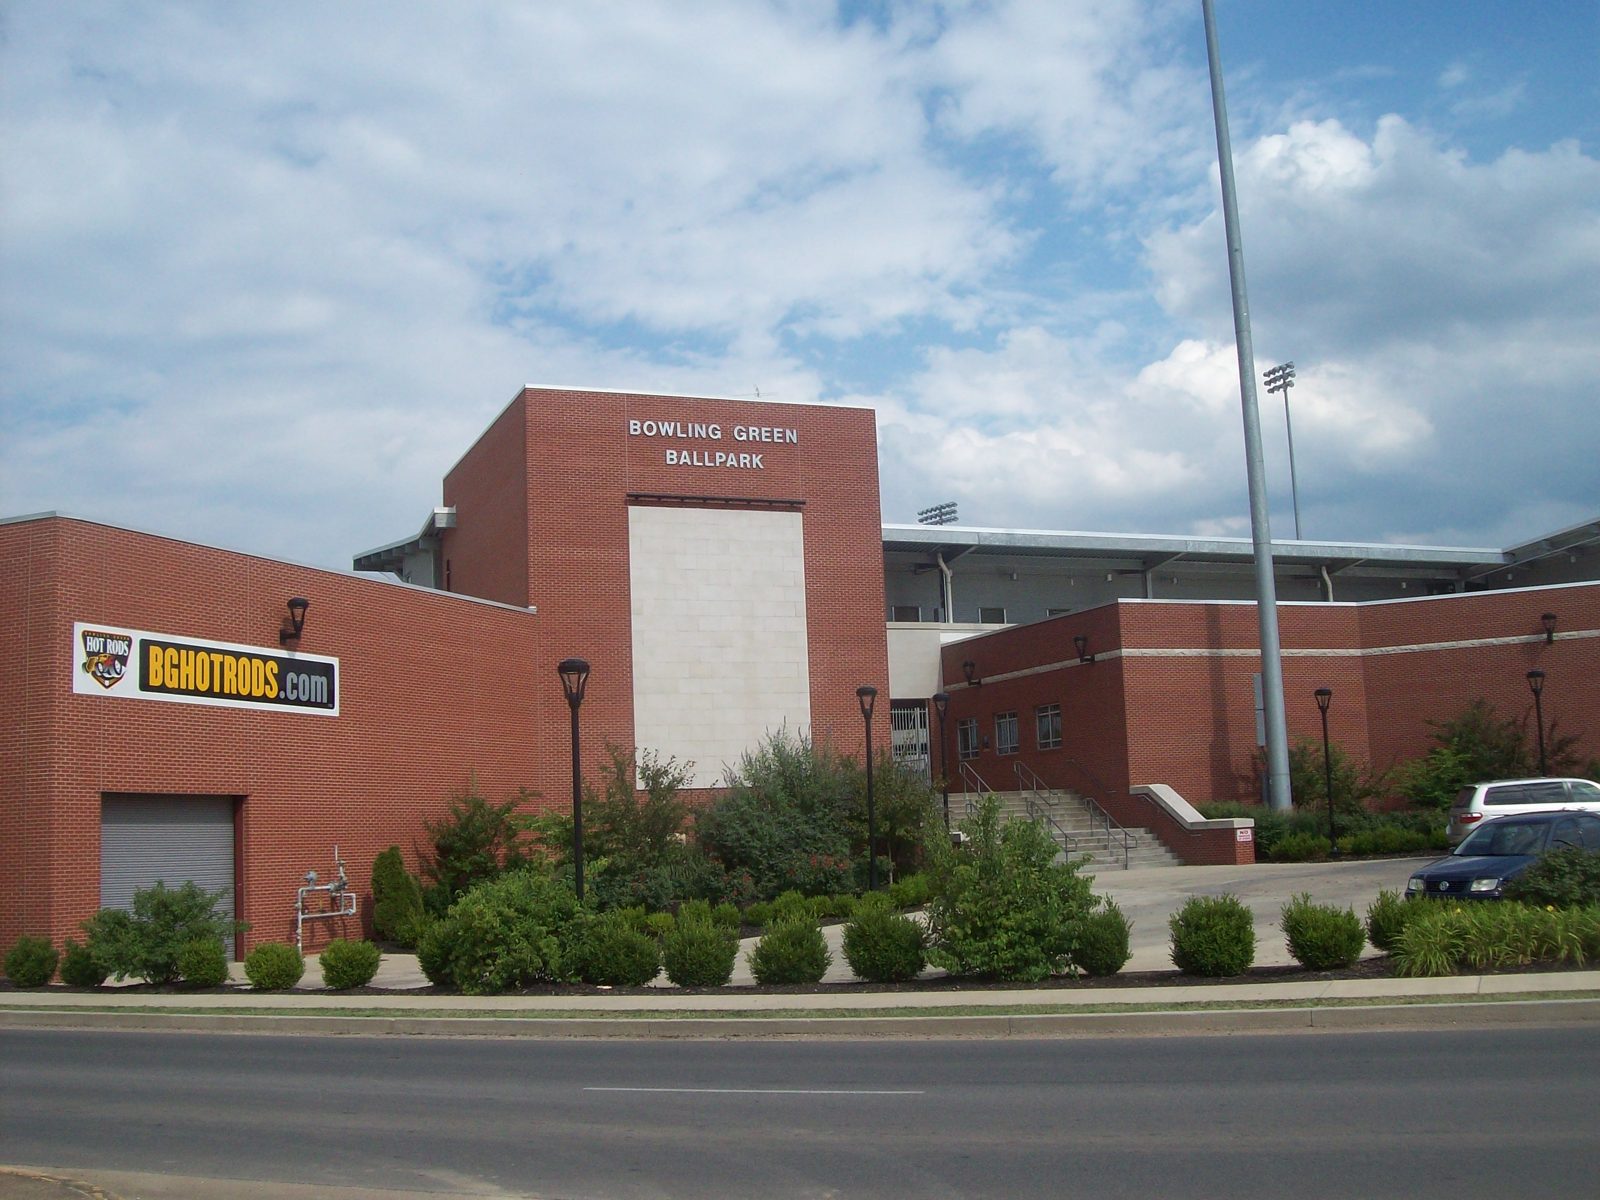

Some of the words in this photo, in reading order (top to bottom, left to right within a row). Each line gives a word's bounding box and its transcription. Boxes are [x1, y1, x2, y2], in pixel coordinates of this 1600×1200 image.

[629, 420, 722, 439] BOWLING
[733, 426, 798, 444] GREEN
[666, 450, 764, 469] BALLPARK
[86, 636, 105, 652] HOT
[107, 639, 129, 656] RODS
[149, 645, 327, 703] BGHOTRODS.com
